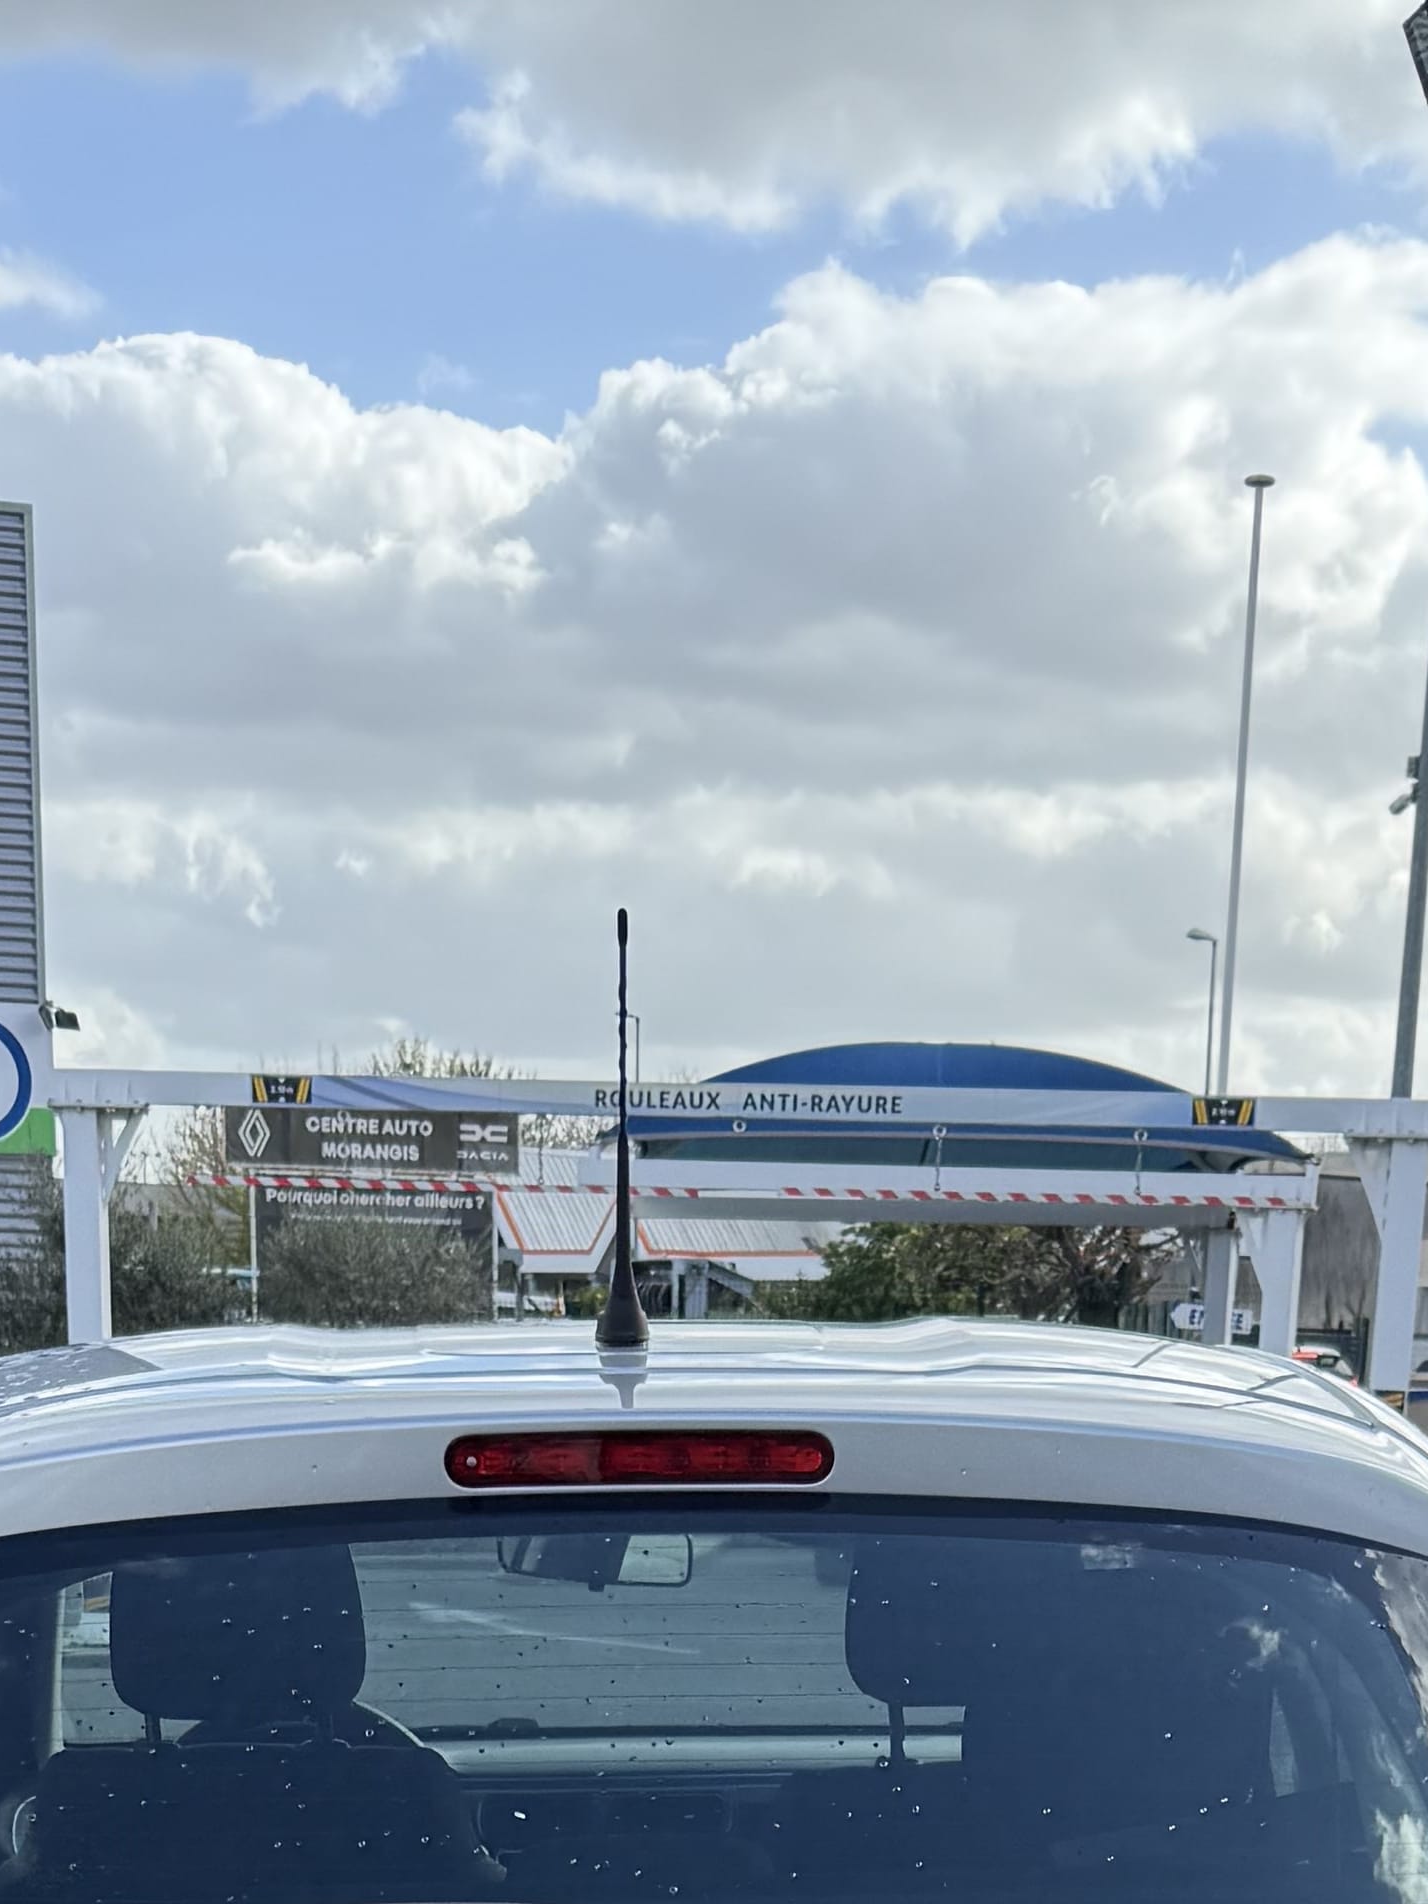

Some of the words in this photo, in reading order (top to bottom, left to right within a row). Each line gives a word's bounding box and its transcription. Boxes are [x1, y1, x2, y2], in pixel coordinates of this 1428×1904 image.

[594, 1089, 721, 1111] ROULEAUX
[742, 1092, 903, 1114] ANTI-RAYURE
[305, 1116, 379, 1136] CENTRE
[385, 1119, 434, 1137] AUTO
[321, 1142, 420, 1162] MORANGIS
[456, 1151, 509, 1161] DACIA
[265, 1188, 337, 1207] Pourquoi
[341, 1191, 410, 1207] chercher
[414, 1193, 473, 1209] ailleurs
